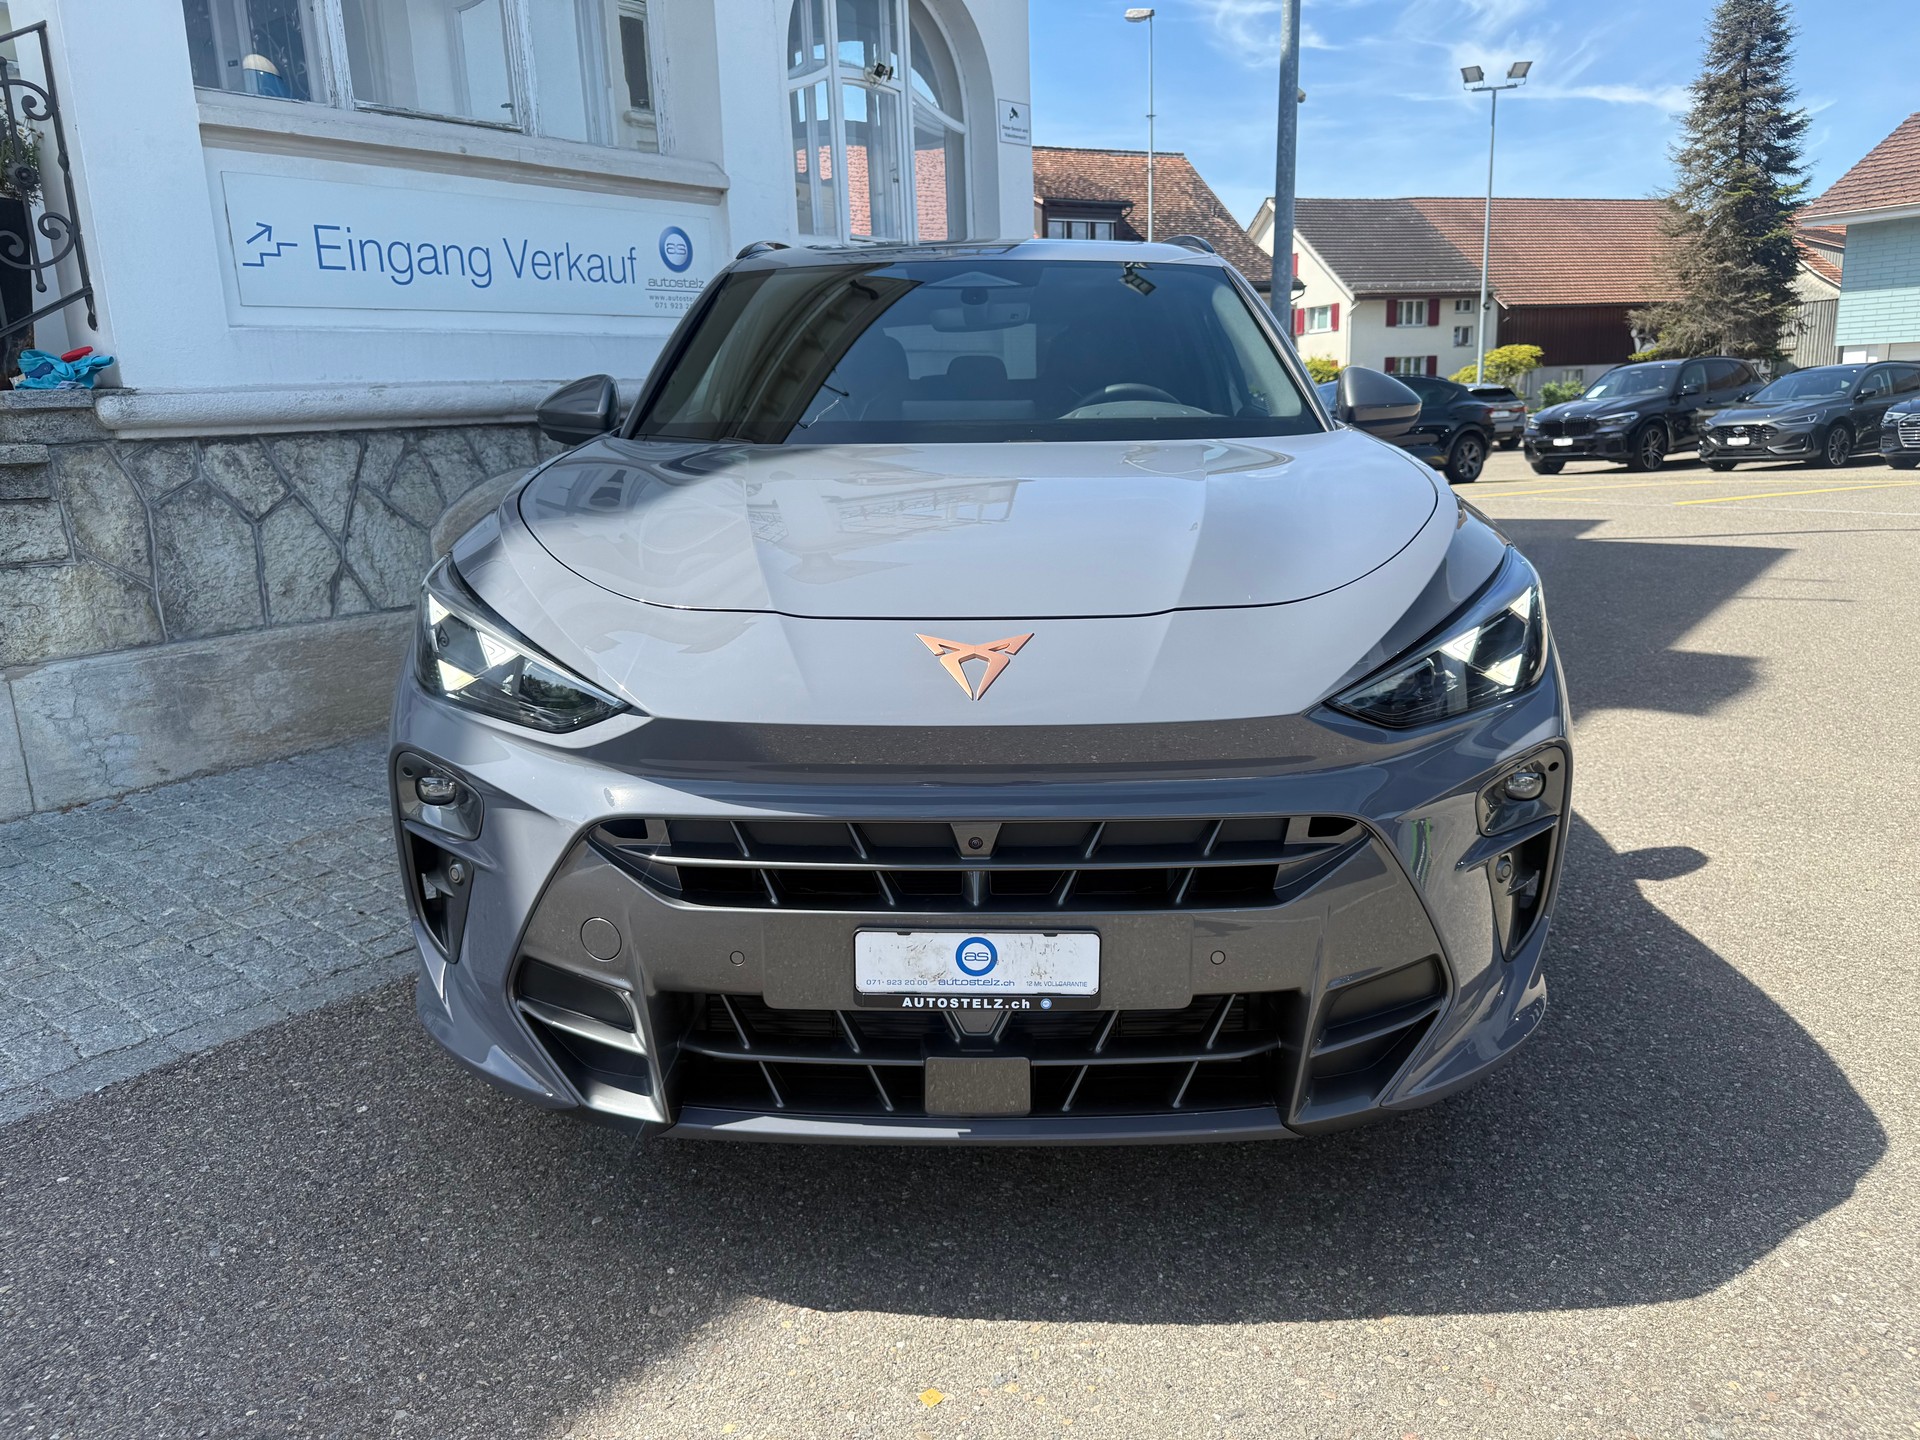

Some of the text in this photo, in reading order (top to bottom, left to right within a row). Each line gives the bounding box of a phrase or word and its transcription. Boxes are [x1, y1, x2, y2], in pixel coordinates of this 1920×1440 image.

[666, 243, 687, 255] as
[313, 224, 637, 289] Eingang Verkauf
[648, 277, 705, 289] autostelz
[964, 951, 989, 962] as
[938, 978, 1016, 987] autostelz.ch
[902, 997, 1031, 1009] AUTOSTELZ.ch
